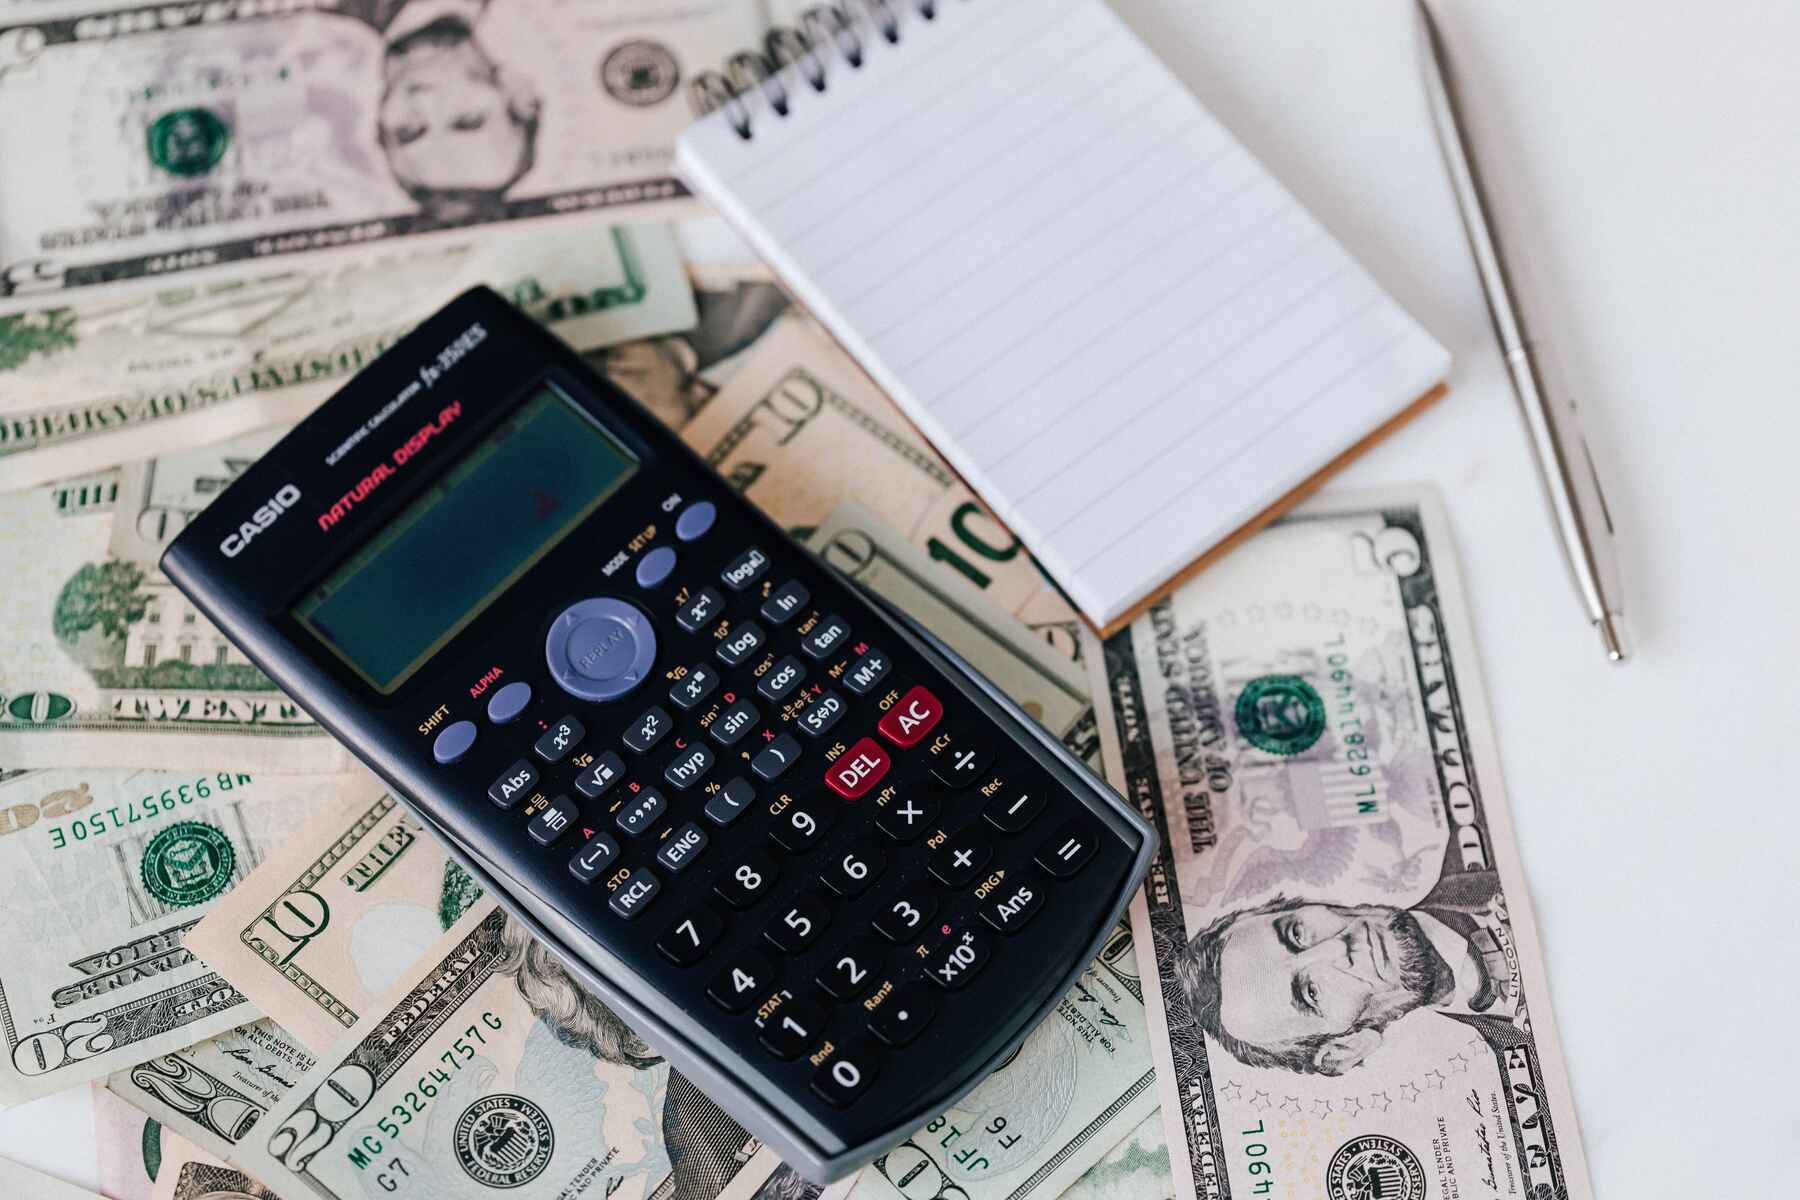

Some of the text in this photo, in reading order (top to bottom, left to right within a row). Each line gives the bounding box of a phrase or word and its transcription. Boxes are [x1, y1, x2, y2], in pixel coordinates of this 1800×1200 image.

[317, 400, 462, 532] NATURAL DISPLAY
[661, 492, 683, 512] ON
[219, 483, 301, 558] CASIO
[601, 550, 631, 577] MODE
[776, 593, 798, 612] ln
[727, 631, 758, 657] log
[813, 623, 843, 650] tan
[853, 641, 869, 655] M
[469, 664, 504, 699] ALPHA
[770, 665, 797, 690] cos
[853, 657, 883, 686] M+
[723, 692, 736, 704] D
[810, 684, 823, 695] Y
[879, 688, 900, 711] OFF
[418, 703, 451, 736] SHIFT
[723, 709, 749, 734] sin
[898, 700, 930, 735] AC
[675, 737, 687, 750] C
[929, 732, 952, 756] nCr
[1166, 684, 1204, 788] UNITED
[1408, 603, 1487, 873] DOLLARS
[672, 751, 706, 780] hyp
[824, 742, 847, 763] INS
[499, 768, 531, 800] Abs
[838, 753, 881, 788] DEL
[1205, 755, 1232, 793] OF
[628, 781, 641, 793] B
[704, 781, 721, 796] %
[876, 783, 898, 808] nPr
[980, 777, 1003, 798] Rec
[1355, 781, 1378, 816] ML
[769, 793, 793, 817] CLR
[582, 827, 595, 839] A
[791, 811, 817, 836] 9
[1183, 790, 1218, 854] THE
[666, 829, 700, 863] ENG
[927, 829, 948, 850] Pol
[340, 824, 416, 892] THE
[842, 854, 868, 880] 6
[606, 868, 631, 891] STO
[734, 863, 763, 890] 8
[619, 878, 653, 910] RCL
[997, 885, 1034, 923] Ans
[784, 909, 812, 937] 5
[892, 900, 921, 927] 3
[675, 919, 701, 949] 7
[836, 956, 867, 985] 2
[1494, 926, 1520, 998] LINCOLN
[382, 938, 484, 1046] FEDERAL
[730, 967, 756, 994] 4
[757, 992, 783, 1020] STAT
[1056, 1006, 1078, 1026] NOTE
[247, 1034, 263, 1047] ALL
[782, 1015, 808, 1039] 1
[1076, 1025, 1094, 1043] THIS
[1085, 1021, 1101, 1037] ALL
[11, 1012, 115, 1077] 20
[253, 1026, 307, 1062] THIS NOTE IS
[809, 1040, 836, 1067] Rnd
[1100, 1036, 1116, 1053] FOR
[831, 1060, 862, 1088] 0
[130, 1052, 261, 1142] 20
[347, 1011, 503, 1170] MG 53264757 G
[267, 1063, 378, 1172] 20
[458, 1098, 511, 1152] UNITED STATES
[1242, 1119, 1265, 1135] L
[1495, 1114, 1506, 1139] United
[466, 1103, 550, 1185] FEDERAL RESERVE SYSTEM
[1437, 1116, 1450, 1149] PRIVATE
[953, 1148, 989, 1172] JF
[1358, 1139, 1403, 1156] SYSTEM
[1432, 1138, 1443, 1175] TENDER
[376, 1157, 410, 1193] G7
[570, 1157, 598, 1187] TENDER
[577, 1146, 620, 1194] AND PRIVATE
[1331, 1150, 1352, 1184] STATES
[1446, 1153, 1454, 1176] AND
